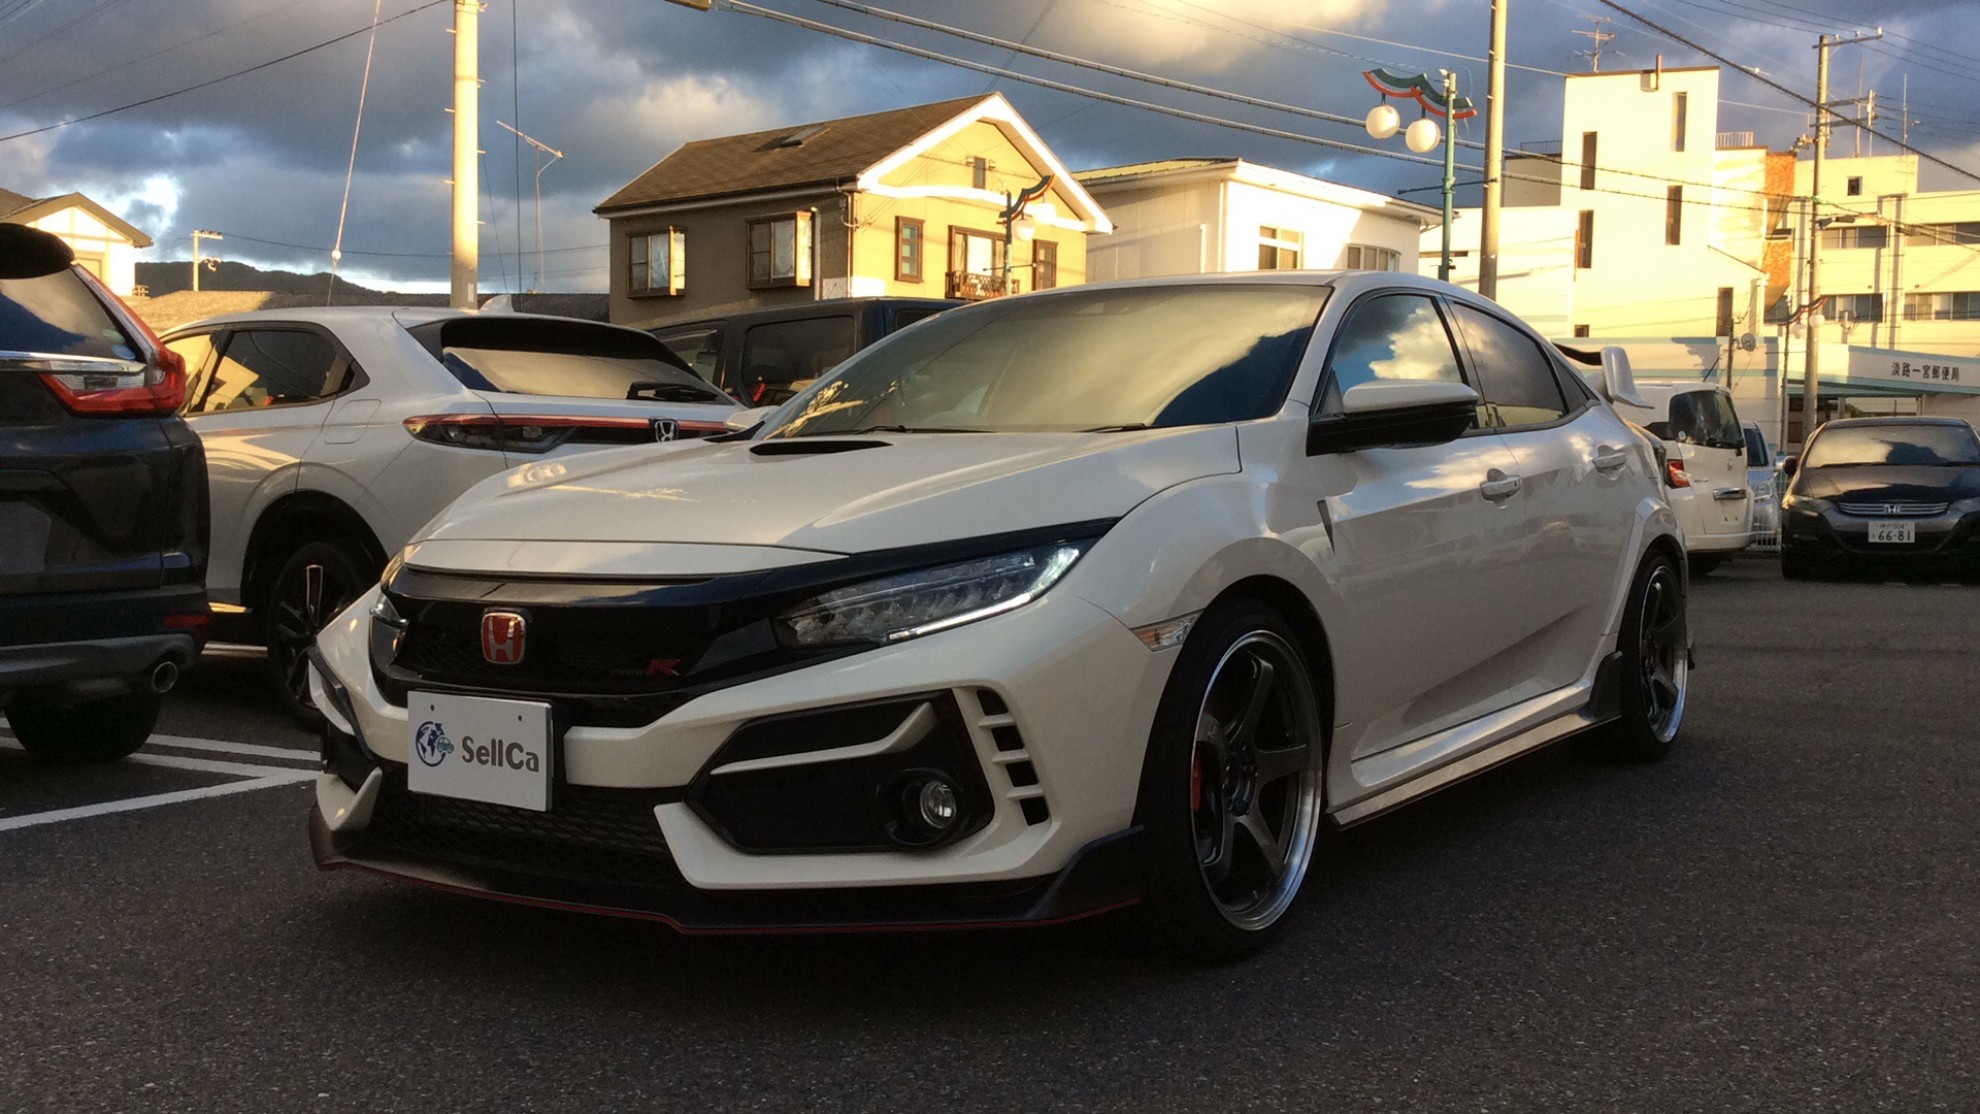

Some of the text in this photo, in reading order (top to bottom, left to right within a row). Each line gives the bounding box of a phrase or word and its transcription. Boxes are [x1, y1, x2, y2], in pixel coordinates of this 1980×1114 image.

[1891, 361, 1960, 382] 淡路一宮郵便局
[1878, 530, 1911, 541] 66-81
[461, 735, 539, 773] SellCa
